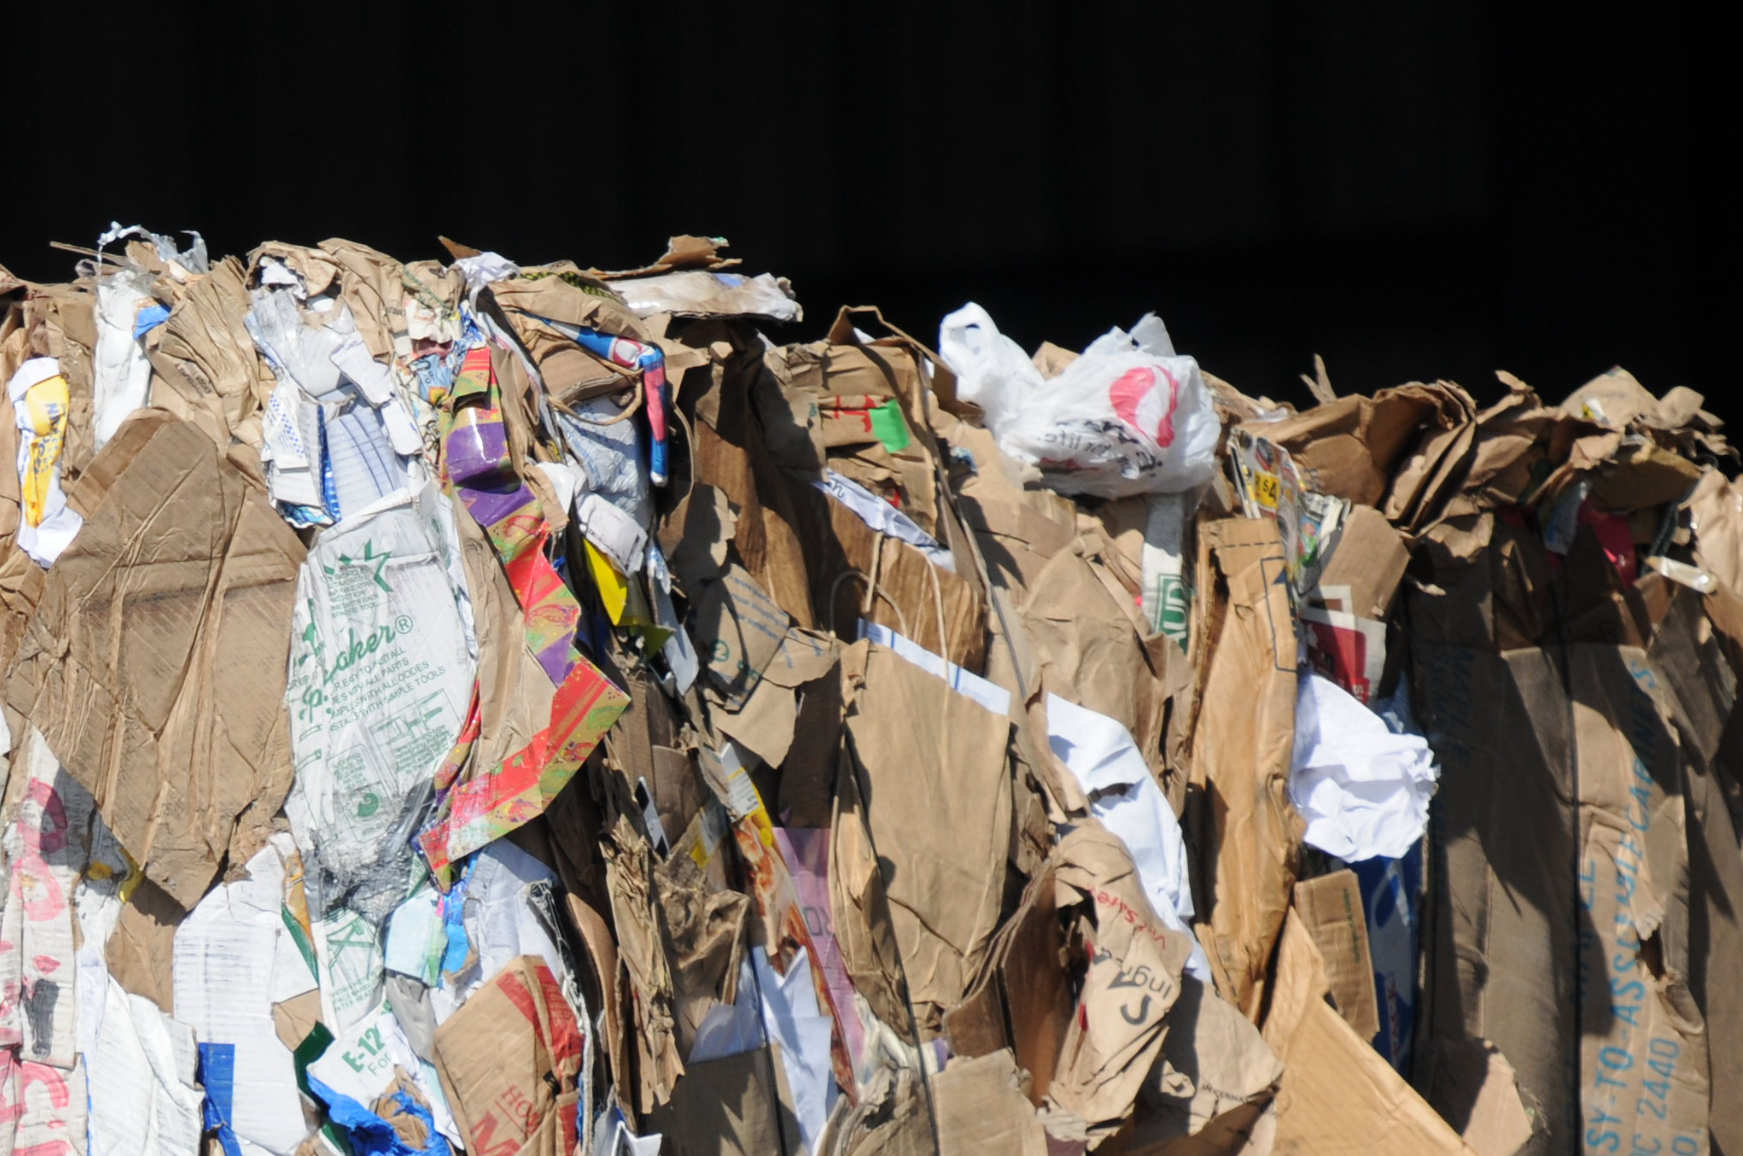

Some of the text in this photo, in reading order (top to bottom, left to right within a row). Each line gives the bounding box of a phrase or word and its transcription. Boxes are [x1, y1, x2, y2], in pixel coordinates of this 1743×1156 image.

[359, 664, 373, 676] TO
[364, 673, 381, 687] ALL
[380, 657, 410, 677] PARTS
[381, 676, 399, 690] ALL
[397, 659, 430, 682] CODES
[382, 682, 414, 704] SIMPLE
[414, 665, 446, 687] TOOLS
[1638, 1036, 1678, 1119] 2440
